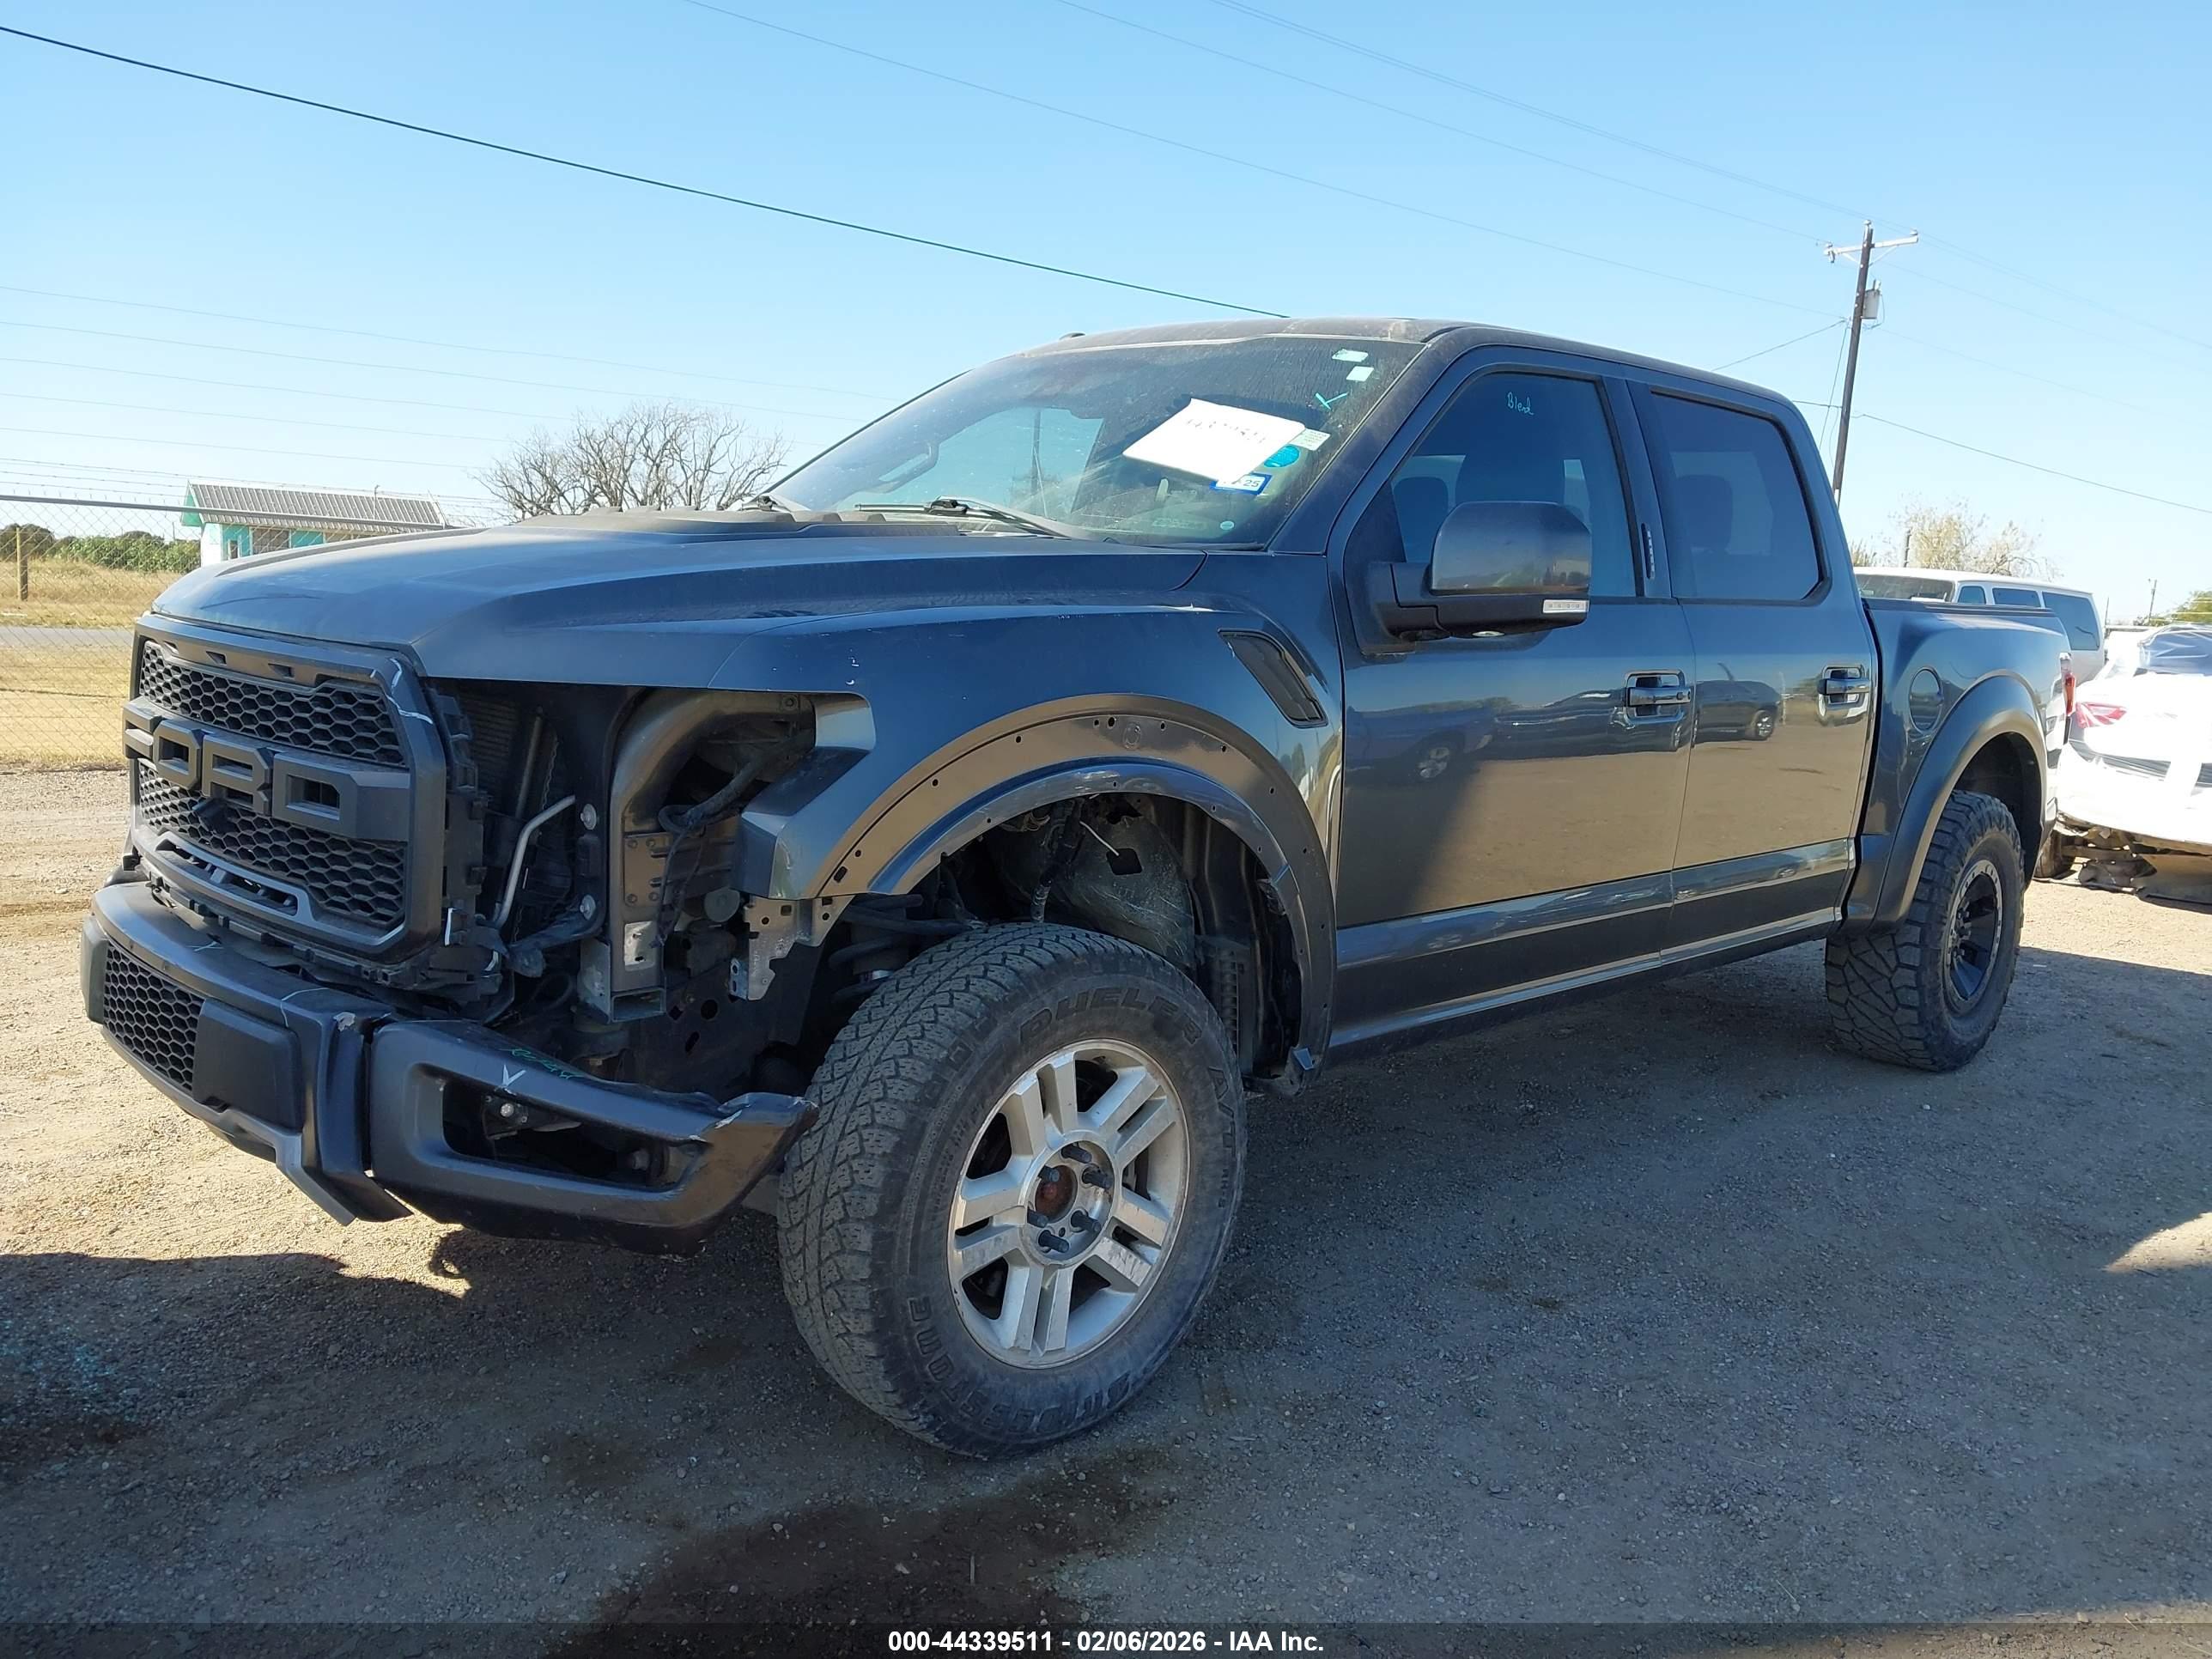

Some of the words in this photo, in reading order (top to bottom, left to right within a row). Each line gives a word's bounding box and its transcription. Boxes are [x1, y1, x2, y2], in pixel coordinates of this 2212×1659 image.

[1243, 479, 1261, 488] 25
[124, 698, 358, 839] FORD
[1019, 988, 1203, 1045] DUELER
